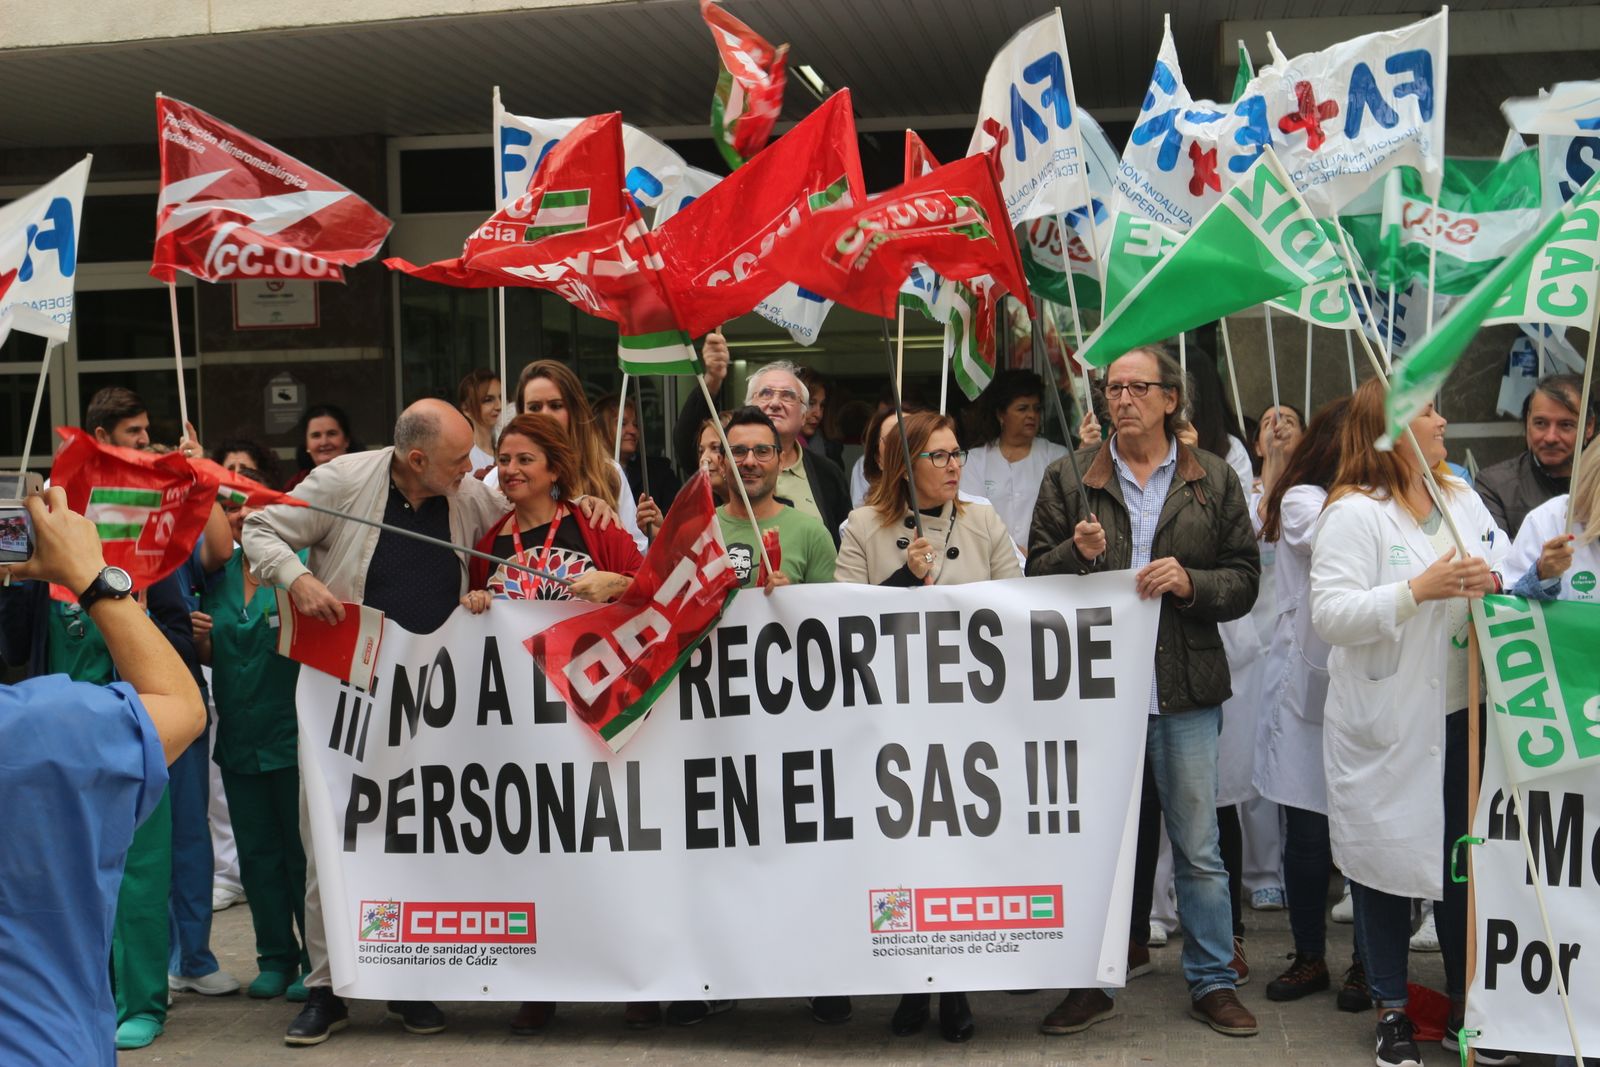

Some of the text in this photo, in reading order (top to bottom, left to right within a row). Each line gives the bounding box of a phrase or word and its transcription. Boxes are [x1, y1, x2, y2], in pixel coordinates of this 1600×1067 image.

[165, 112, 309, 189] Federación Minerometalúrgica
[1141, 181, 1193, 227] ANDALUZA
[214, 243, 339, 277] CC.OO.
[388, 646, 457, 747] NO
[477, 636, 513, 726] A
[678, 608, 1006, 721] RECORTES
[1031, 607, 1116, 701] DE
[343, 762, 662, 855] PERSONAL
[684, 755, 760, 850] EN
[783, 749, 854, 844] EL
[876, 741, 1002, 839] SAS
[358, 943, 537, 957] sindicato de sanidad y sectores
[872, 929, 1064, 945] sindicato de sanidad y sectores
[873, 941, 1020, 957] sociosanitarios de Cádiz
[358, 954, 498, 966] sociosanitarios de Cádiz
[1485, 919, 1581, 996] Por
